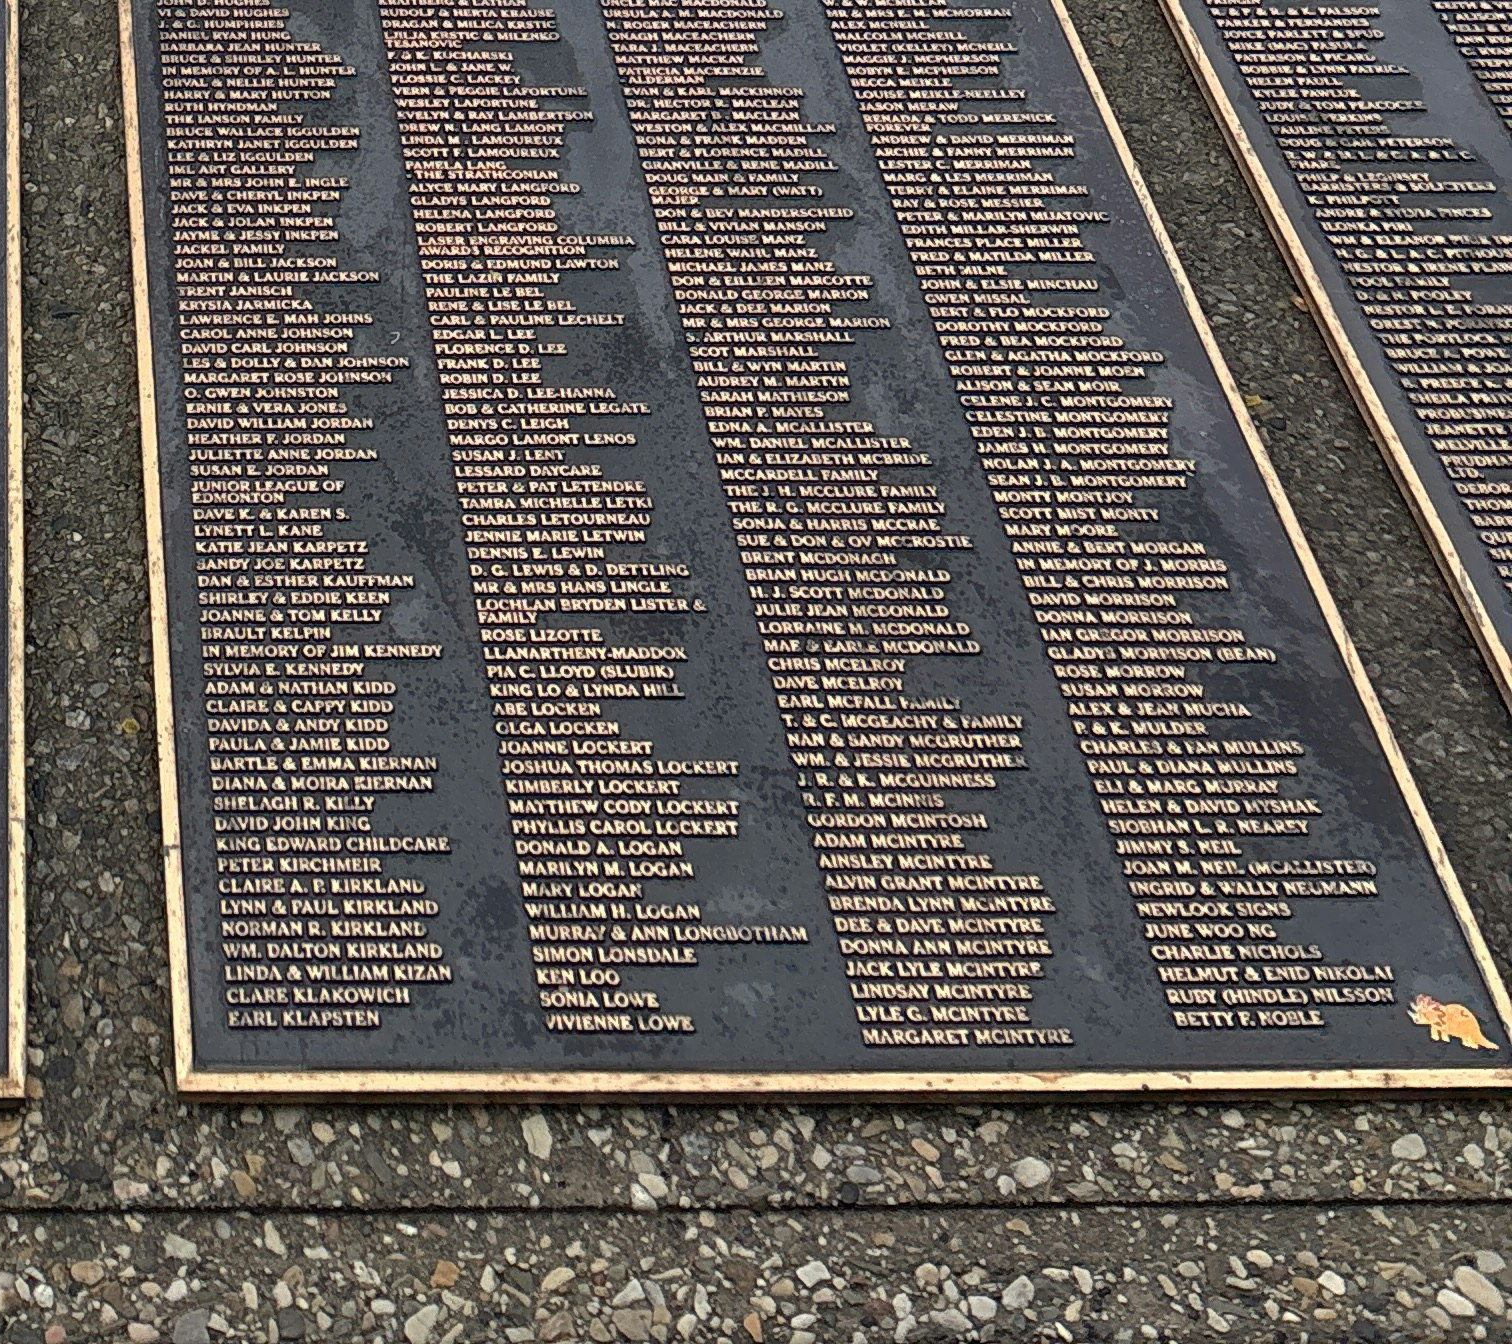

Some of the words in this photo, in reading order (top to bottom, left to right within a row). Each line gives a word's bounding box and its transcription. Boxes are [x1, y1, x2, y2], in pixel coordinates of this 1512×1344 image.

[454, 465, 527, 478] LESSARD
[529, 464, 603, 477] DAYCARE
[1004, 523, 1052, 537] MARY
[1054, 523, 1119, 537] MOORE
[480, 628, 527, 642] ROSE
[529, 628, 604, 642] LIZOTTE
[1053, 664, 1103, 679] ROSE
[1103, 664, 1185, 679] MORROW
[524, 903, 608, 919] WILLIAM
[610, 903, 632, 919] H.
[634, 903, 701, 920] LOGAN
[1135, 902, 1234, 917] NEWLOOK
[1235, 902, 1292, 917] SIGNS
[833, 916, 874, 933] DEE
[876, 918, 893, 933] &
[895, 917, 946, 934] DAVE
[947, 917, 1045, 933] MCINTYRE
[222, 942, 262, 958] WM.
[266, 942, 341, 959] DALTON
[346, 942, 443, 959] KIRKLAND
[532, 946, 594, 963] SIMON
[597, 946, 697, 963] LONSDALE
[1150, 944, 1236, 960] CHARLIE
[1236, 944, 1323, 960] NICHOLS
[224, 965, 283, 981] LINDA
[286, 965, 302, 981] &
[305, 964, 389, 981] WILLIAM
[393, 964, 452, 981] KIZAN
[535, 968, 575, 985] KEN
[578, 968, 621, 985] LOO
[226, 987, 289, 1004] CLARE
[292, 987, 410, 1004] KLAKOWICH
[850, 982, 930, 999] LINDSAY
[933, 983, 1033, 1000] MCINTYRE
[1165, 988, 1217, 1004] RUBY
[1221, 988, 1309, 1005] (HINDLE)
[1310, 987, 1395, 1003] NILSSON
[228, 1010, 278, 1027] EARL
[282, 1009, 380, 1026] KLAPSTEN
[855, 1005, 905, 1022] LYLE
[906, 1005, 928, 1022] G.
[929, 1005, 1030, 1022] MCINTYRE
[1172, 1011, 1234, 1027] BETTY
[1237, 1011, 1256, 1027] F.
[546, 1014, 634, 1031] VIVIENNE
[637, 1015, 695, 1031] LOWE
[861, 1028, 969, 1045] MARGARET
[973, 1028, 1074, 1045] MCINTYRE
